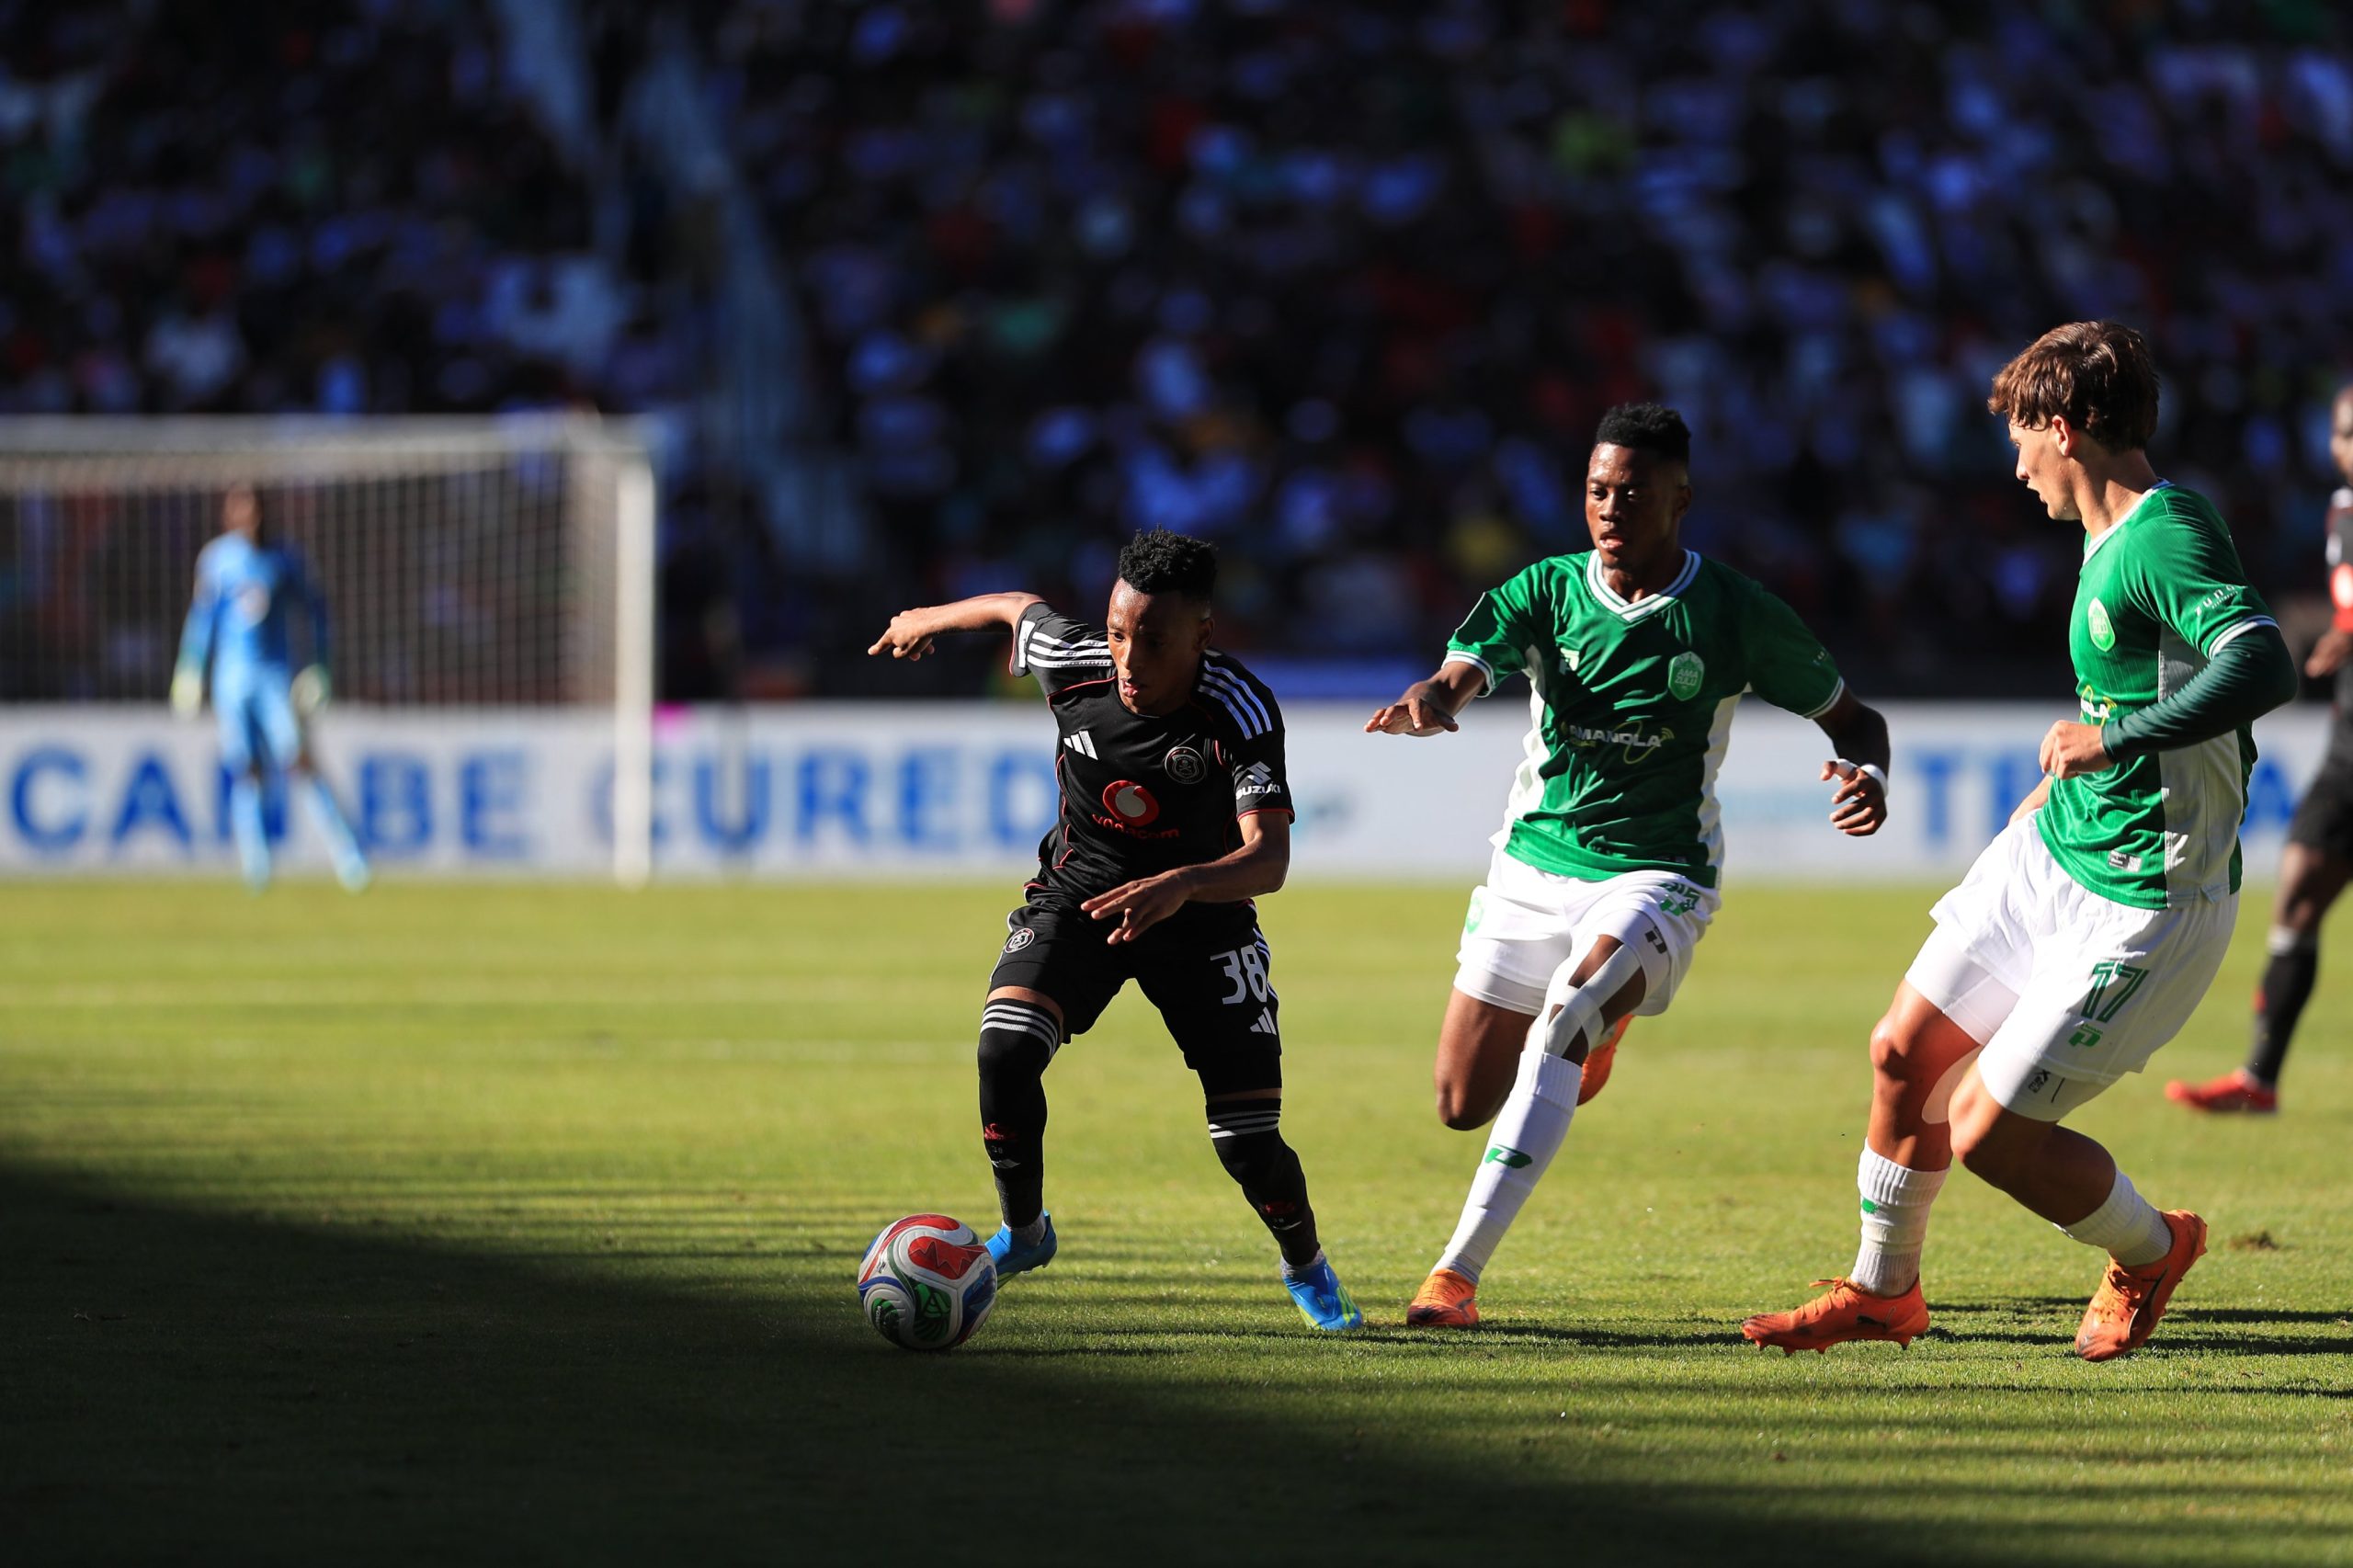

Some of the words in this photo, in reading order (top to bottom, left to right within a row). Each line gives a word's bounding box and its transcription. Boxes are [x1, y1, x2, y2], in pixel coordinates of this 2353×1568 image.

[358, 750, 538, 855] BE
[588, 743, 1059, 855] CURED
[1235, 783, 1281, 801] SUZUKI
[1210, 944, 1267, 1005] 38
[2080, 960, 2151, 1023] 17
